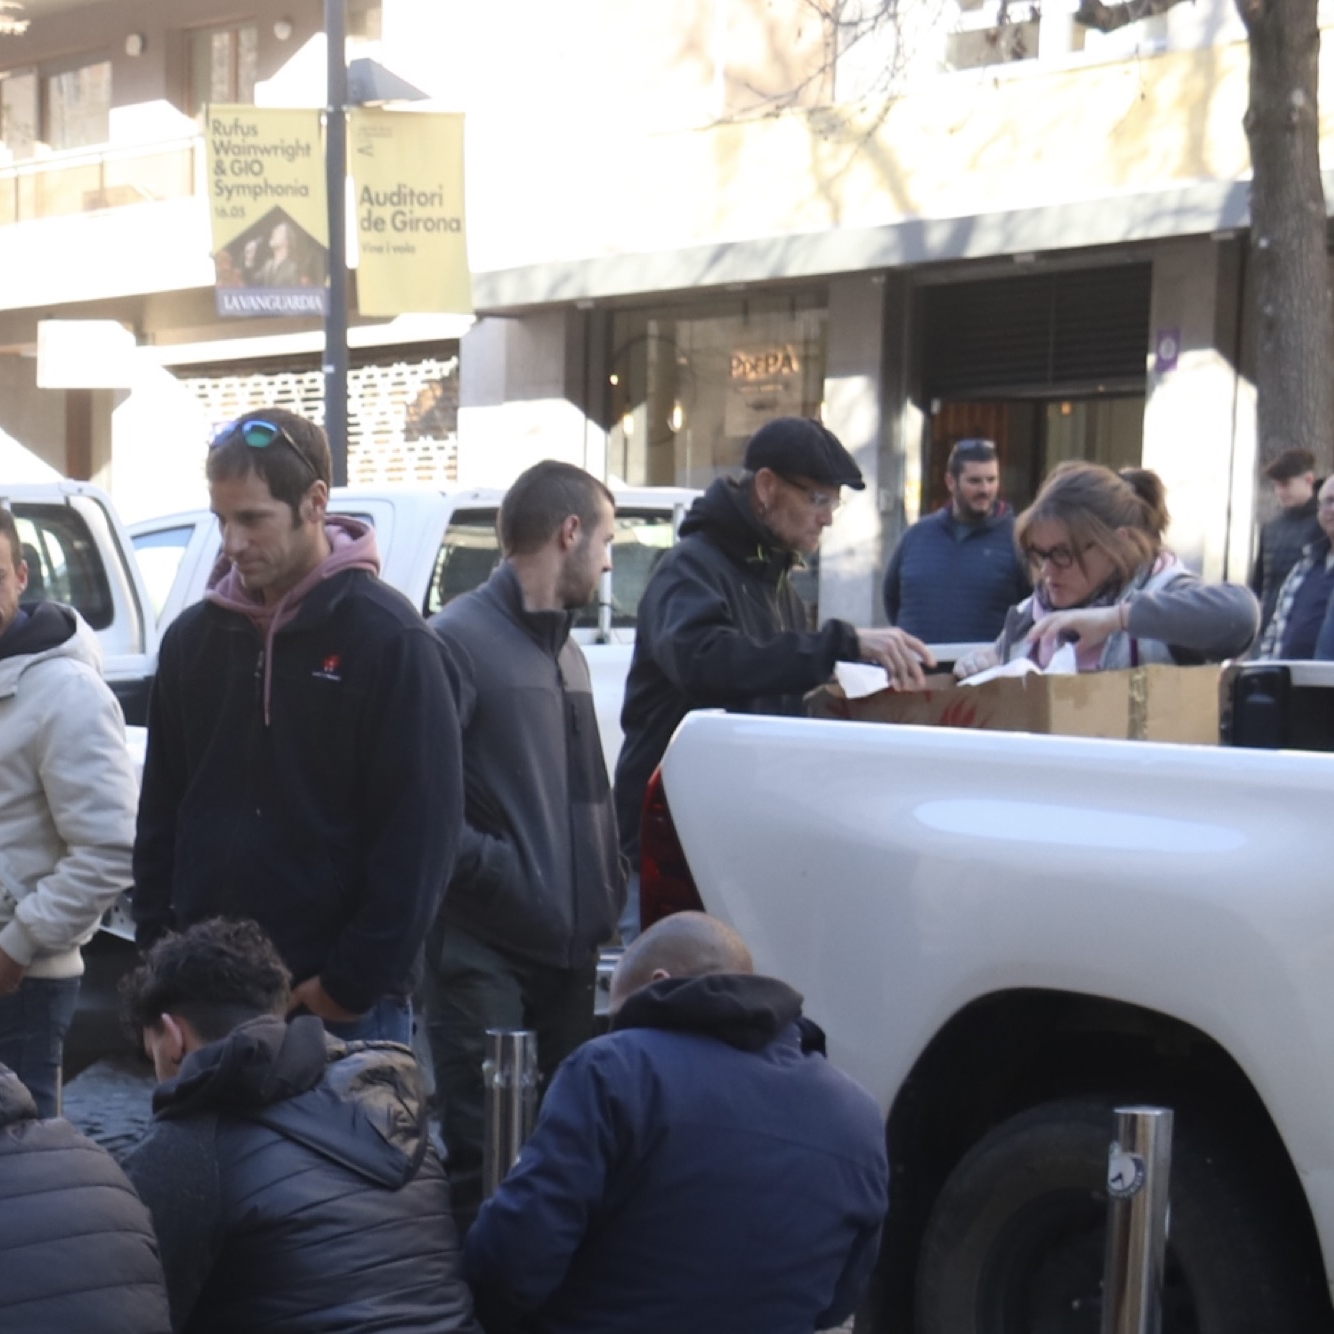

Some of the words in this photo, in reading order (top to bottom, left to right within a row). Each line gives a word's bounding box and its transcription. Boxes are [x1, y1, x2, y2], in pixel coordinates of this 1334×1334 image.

[212, 119, 259, 137] Rufus
[212, 138, 312, 162] Wainwright
[213, 160, 228, 176] &
[230, 159, 265, 176] GIO
[214, 178, 310, 202] Symphonia
[360, 184, 444, 208] Auditori
[360, 211, 386, 234] de
[391, 211, 462, 234] Girona
